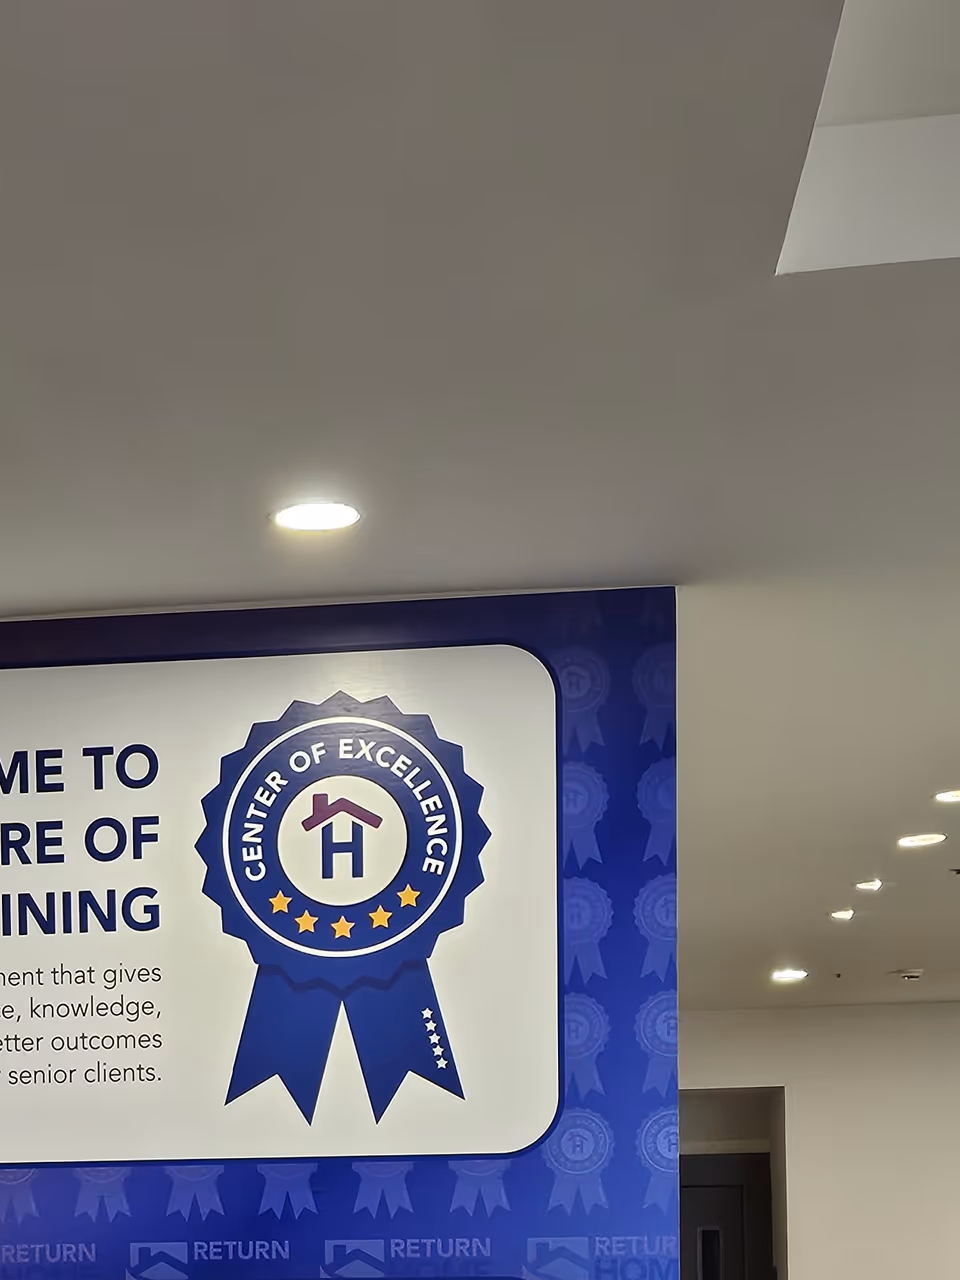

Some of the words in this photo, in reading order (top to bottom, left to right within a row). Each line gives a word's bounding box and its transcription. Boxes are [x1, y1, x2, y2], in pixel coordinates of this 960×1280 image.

[81, 743, 160, 791] TO
[242, 769, 289, 882] CENTER
[289, 742, 327, 773] OF
[338, 738, 448, 876] EXCELLENCE
[84, 815, 160, 863] OF
[321, 820, 364, 880] H
[50, 962, 96, 986] that
[102, 962, 162, 991] gives
[29, 993, 162, 1023] knowledge,
[50, 1032, 163, 1052] outcomes
[8, 1063, 78, 1086] senior
[83, 1060, 162, 1084] clients.
[1, 1243, 97, 1264] RETURN
[193, 1240, 291, 1260] RETURN
[390, 1237, 491, 1258] RETURN
